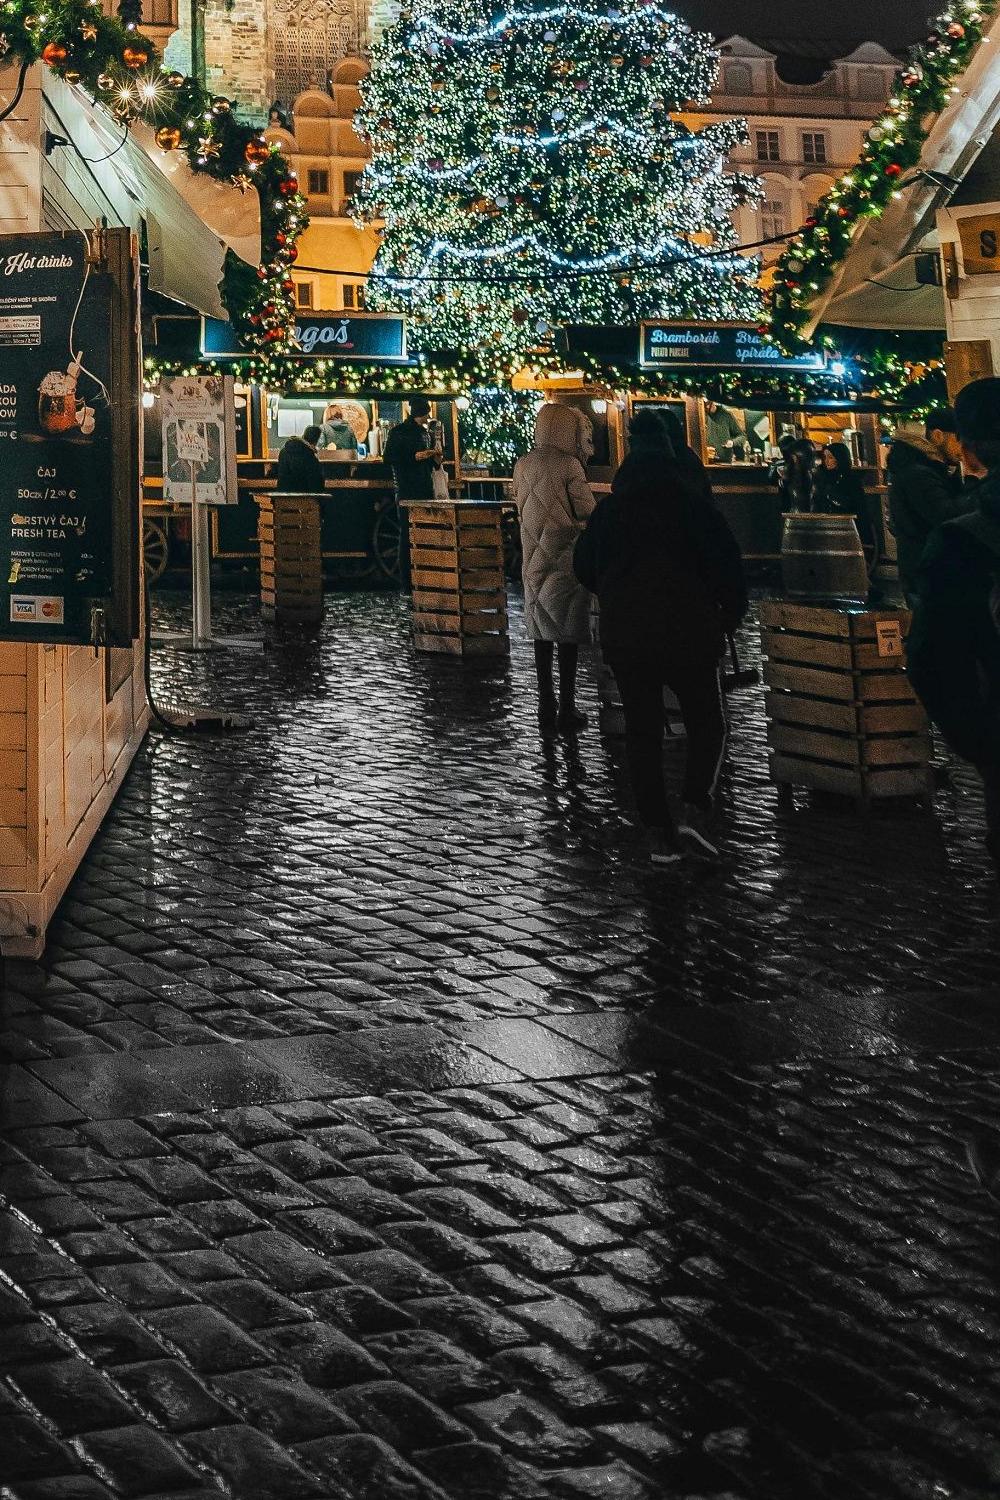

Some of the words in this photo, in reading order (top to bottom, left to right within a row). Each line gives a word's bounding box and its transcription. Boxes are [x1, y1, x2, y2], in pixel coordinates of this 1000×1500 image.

[5, 252, 35, 276] Hot
[36, 254, 73, 269] drinks
[650, 329, 721, 344] Bramborák
[735, 345, 780, 362] spirála
[9, 430, 18, 440] €
[37, 466, 56, 477] ČAJ
[68, 489, 77, 499] €
[59, 514, 79, 526] ČAJ
[11, 528, 43, 538] FRESH
[46, 529, 66, 538] TEA
